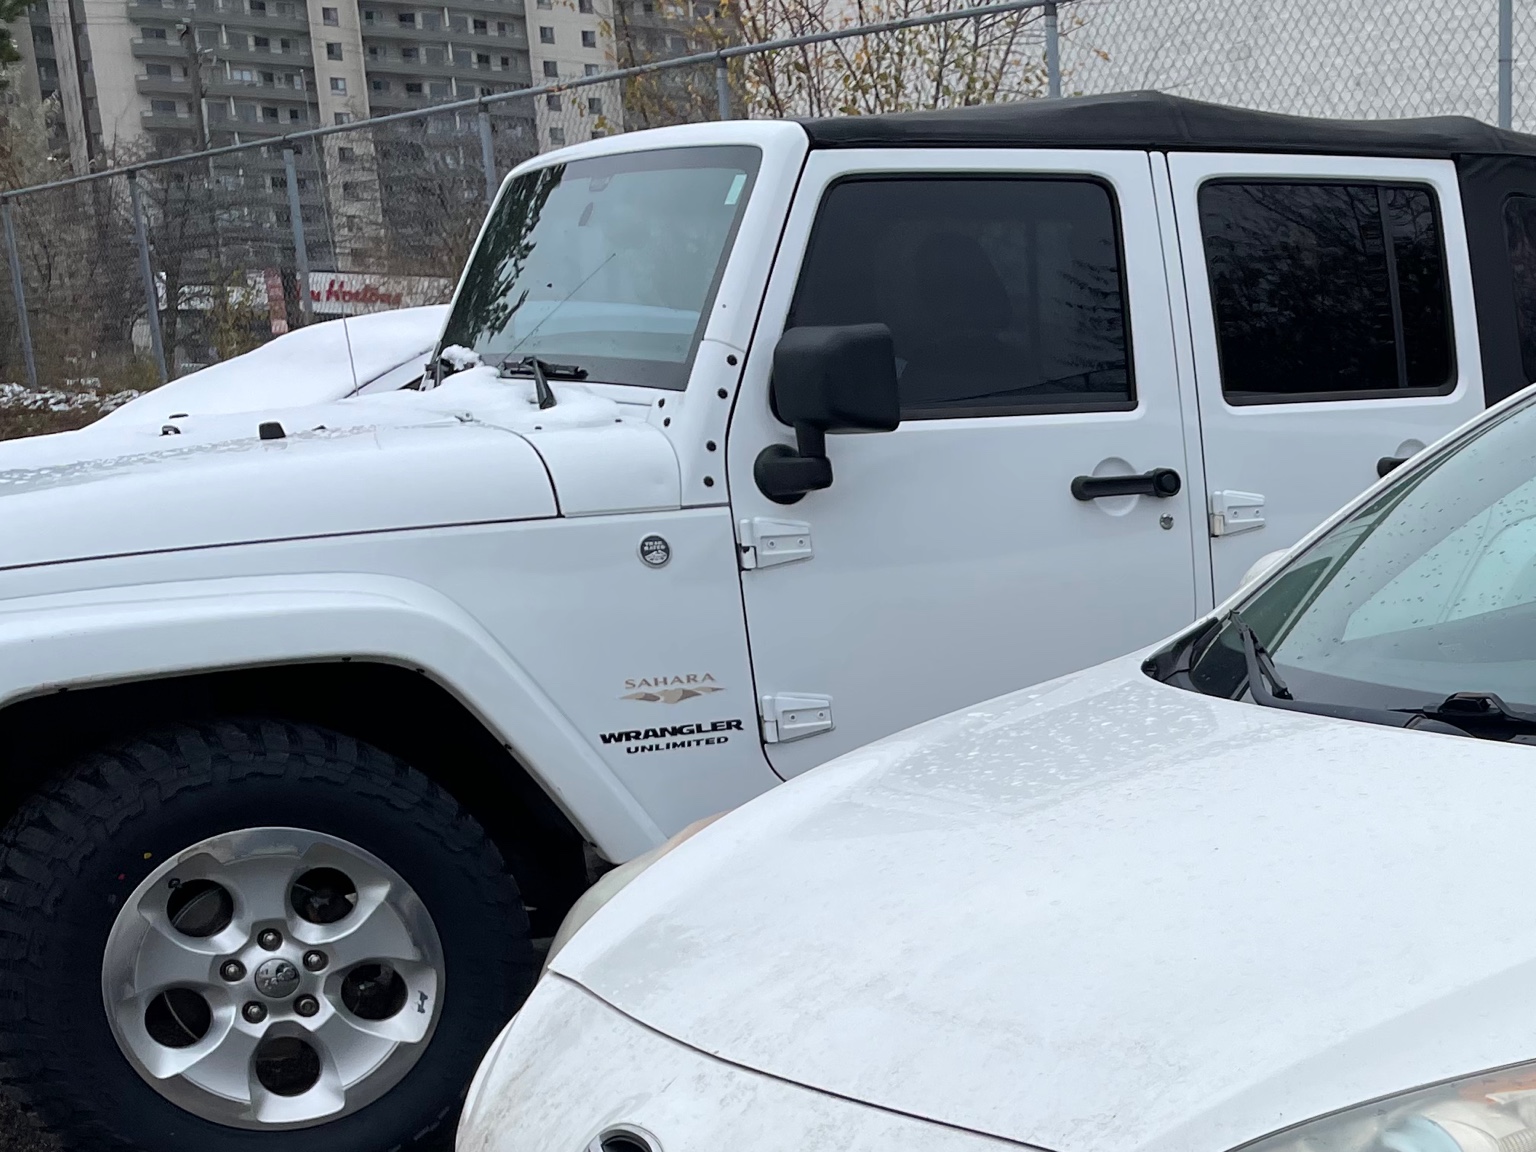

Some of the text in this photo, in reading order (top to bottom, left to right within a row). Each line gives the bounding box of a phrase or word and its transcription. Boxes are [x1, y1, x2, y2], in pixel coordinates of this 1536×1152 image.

[624, 673, 716, 690] SAHARA
[600, 719, 744, 744] WRANGLER
[626, 736, 729, 754] UNLIMITED
